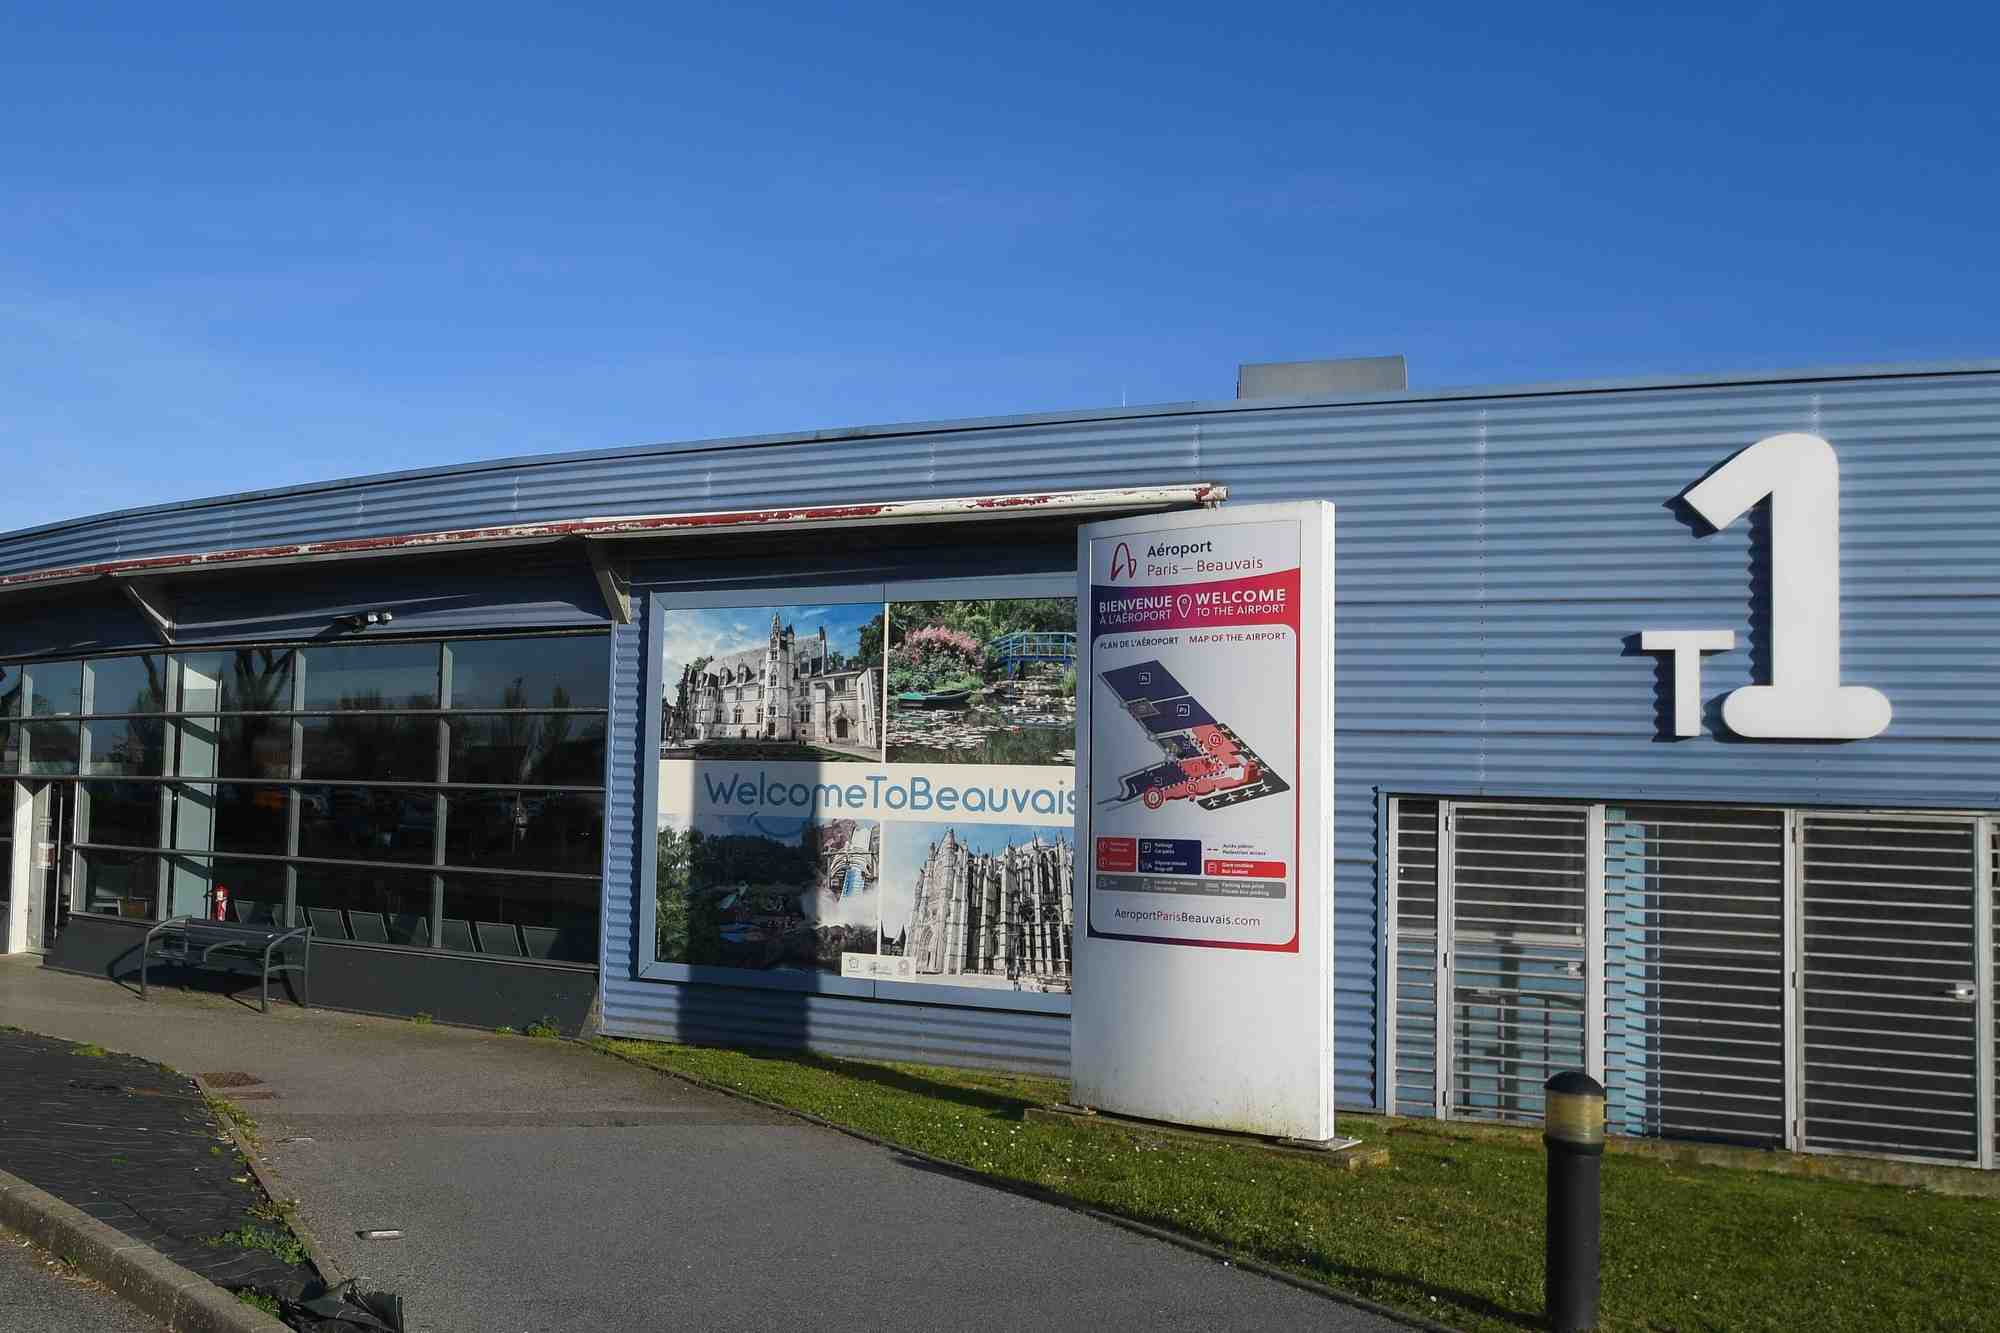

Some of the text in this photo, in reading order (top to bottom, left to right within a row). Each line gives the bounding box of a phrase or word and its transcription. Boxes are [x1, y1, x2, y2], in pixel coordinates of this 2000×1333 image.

[1147, 540, 1213, 559] Aéroport
[1147, 562, 1179, 577] Paris
[1197, 556, 1264, 573] Beauvais
[1099, 595, 1173, 613] BIENVENUE
[1195, 588, 1286, 605] WELCOME
[1196, 604, 1286, 617] TO THE AIRPORT
[1120, 639, 1130, 649] DE
[1189, 631, 1287, 644] MAP OF THE AIRPORT
[1114, 907, 1261, 927] AeroportParisBeauvais.com
